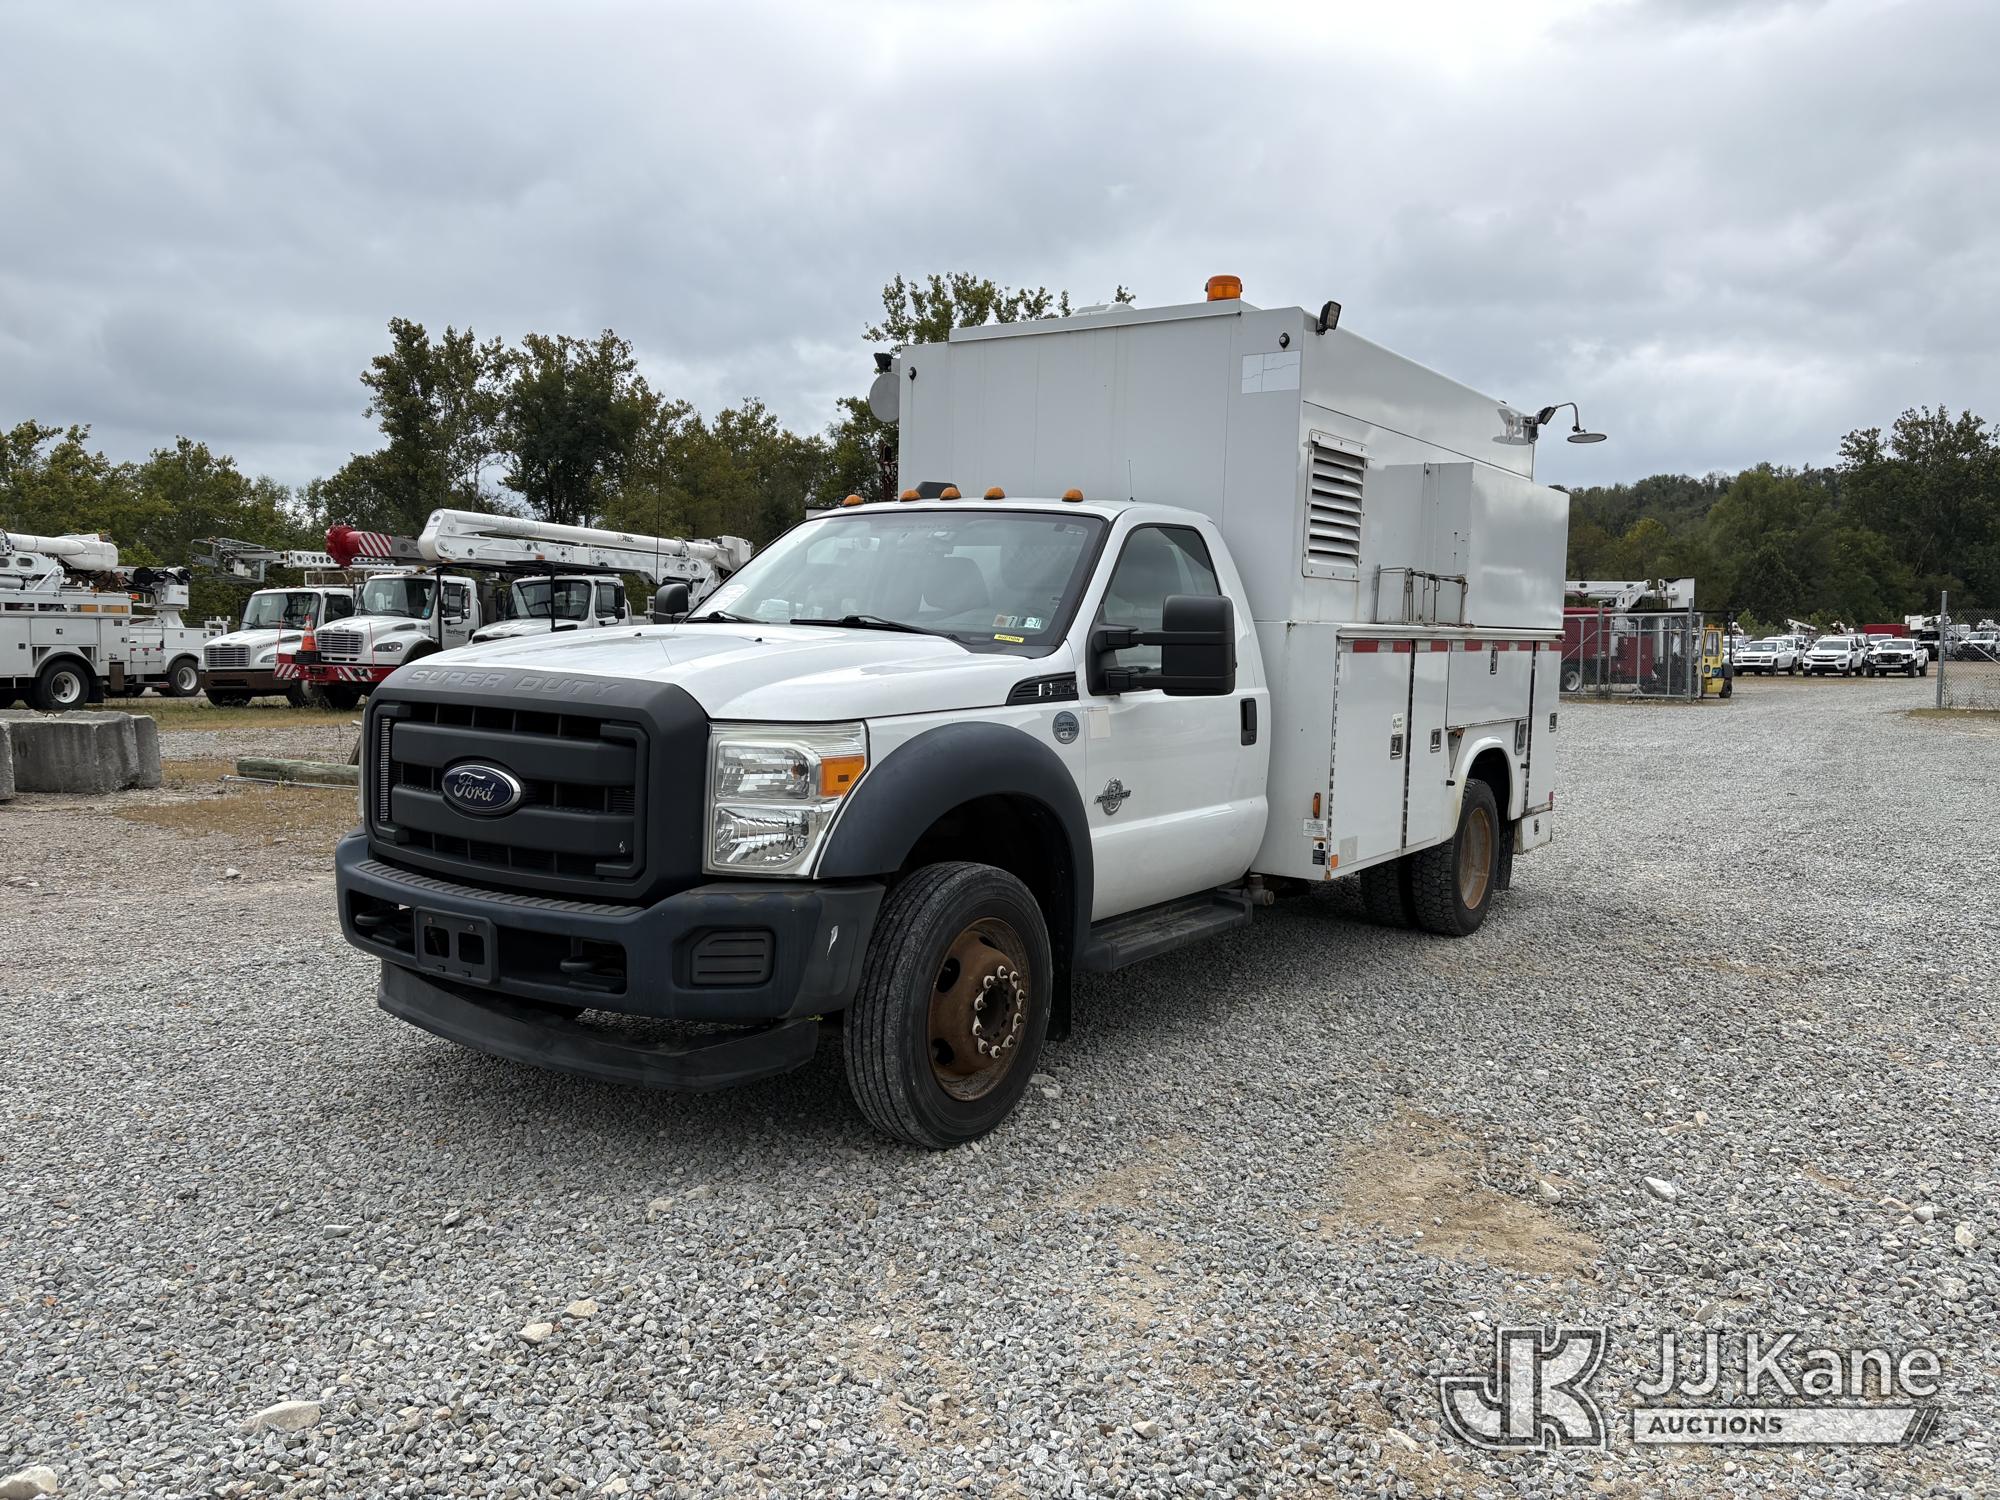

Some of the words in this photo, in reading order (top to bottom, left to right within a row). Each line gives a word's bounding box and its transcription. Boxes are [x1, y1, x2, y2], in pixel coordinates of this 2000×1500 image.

[407, 669, 508, 688] SUPER
[512, 675, 623, 697] DUTY
[453, 771, 496, 802] Ford
